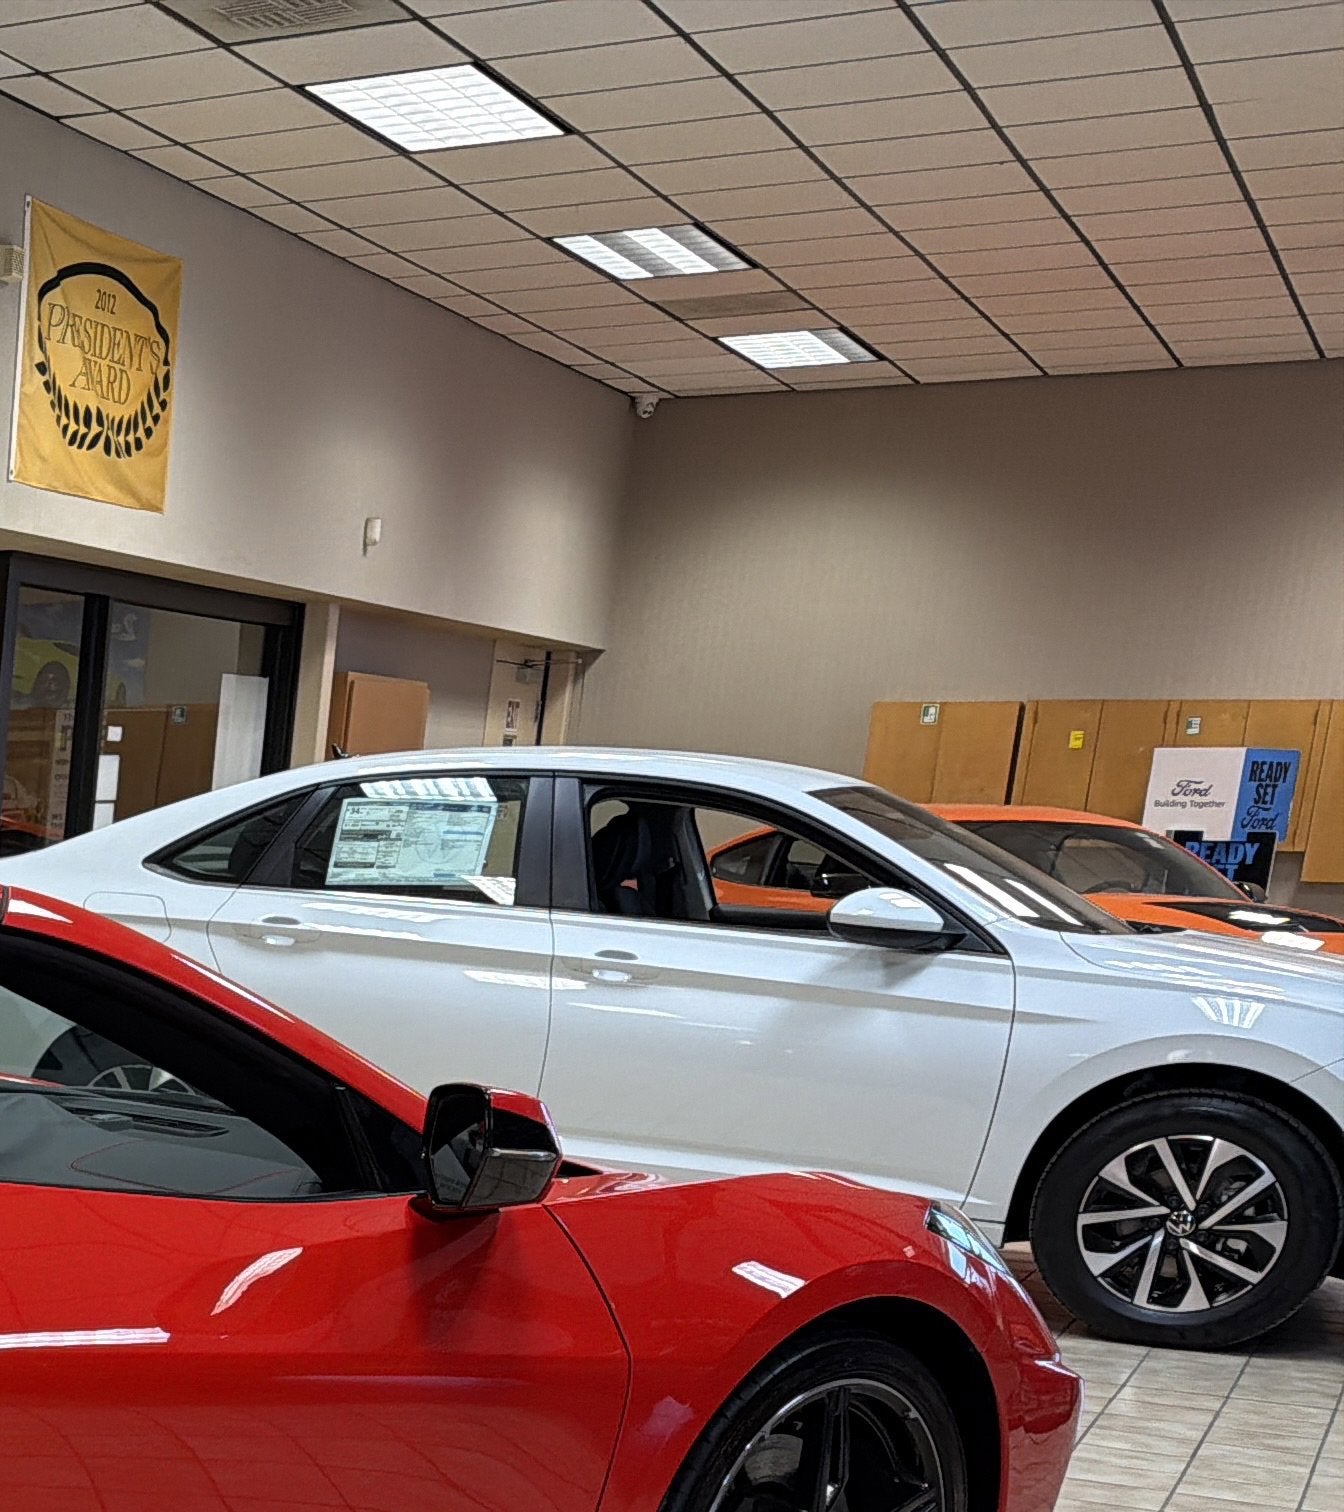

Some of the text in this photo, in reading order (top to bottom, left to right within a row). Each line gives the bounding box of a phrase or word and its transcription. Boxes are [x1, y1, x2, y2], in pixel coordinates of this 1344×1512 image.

[95, 288, 117, 315] 2012
[44, 302, 162, 376] PRESIDENT'S
[68, 356, 131, 405] AWARD
[1248, 760, 1292, 783] READY
[1171, 779, 1214, 797] Ford
[1253, 783, 1279, 806] SET
[1153, 800, 1226, 809] Building Together
[1240, 805, 1280, 830] Ford
